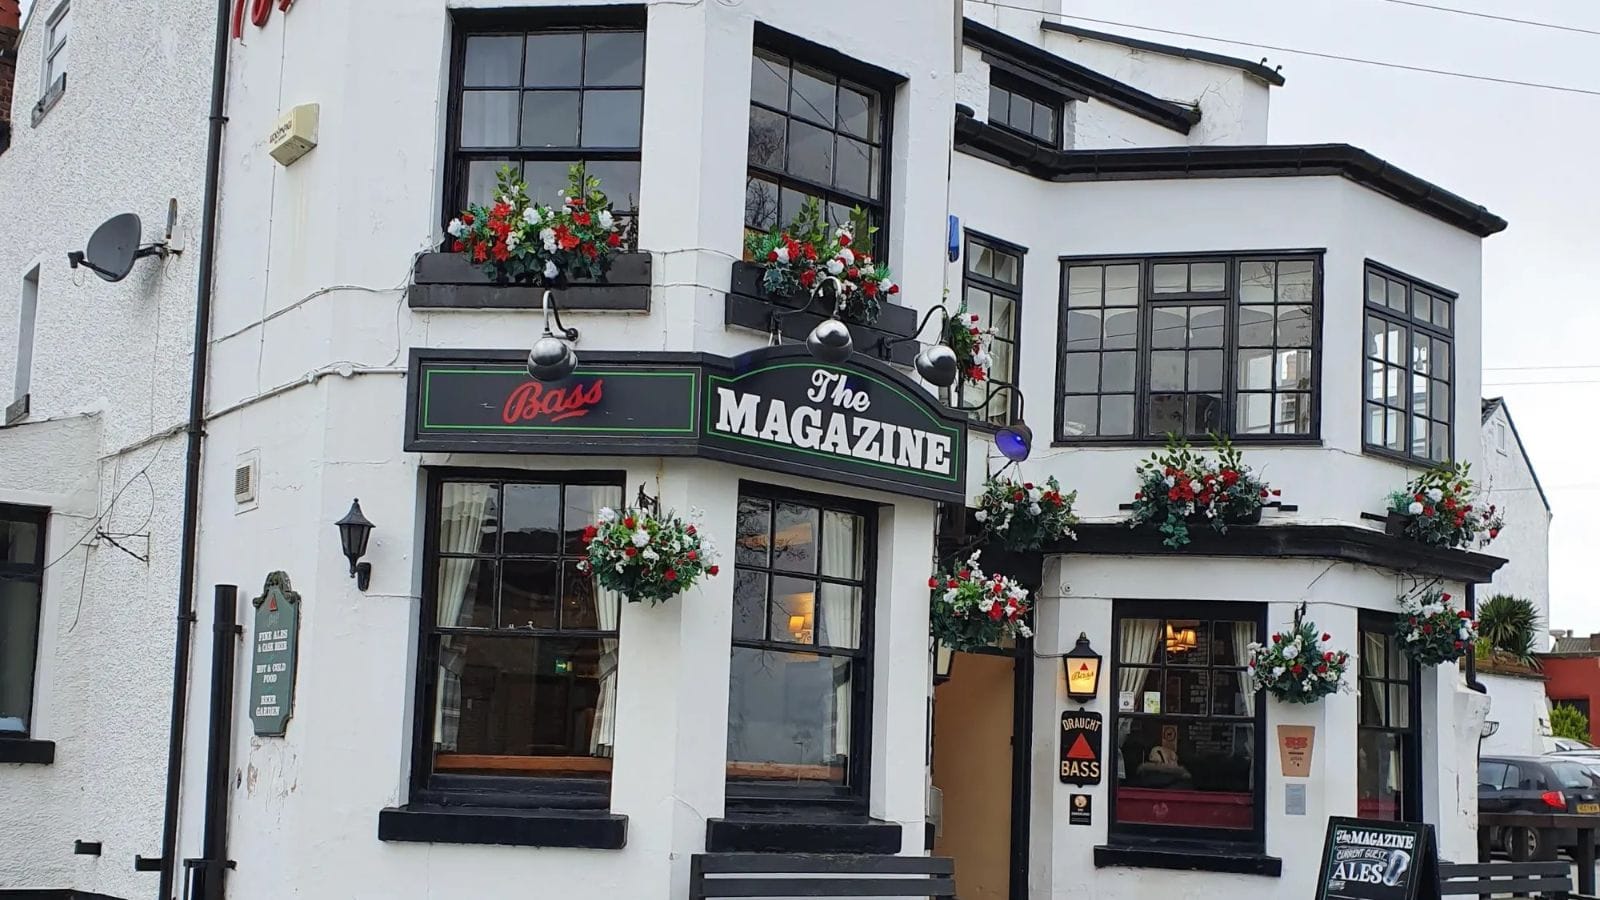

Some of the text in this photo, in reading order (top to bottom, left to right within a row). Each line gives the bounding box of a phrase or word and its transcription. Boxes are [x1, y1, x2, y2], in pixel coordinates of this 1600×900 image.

[807, 369, 870, 412] The
[503, 379, 604, 423] Bass
[716, 387, 951, 475] MAGAZINE
[273, 629, 288, 640] ALES
[272, 663, 286, 672] COLD
[263, 674, 277, 683] FOOD
[256, 706, 280, 716] GARDEN
[1062, 717, 1102, 732] DRAUGHT
[1061, 761, 1100, 777] BASS
[1351, 831, 1414, 849] MAGAZINE
[1332, 862, 1384, 884] ALES
